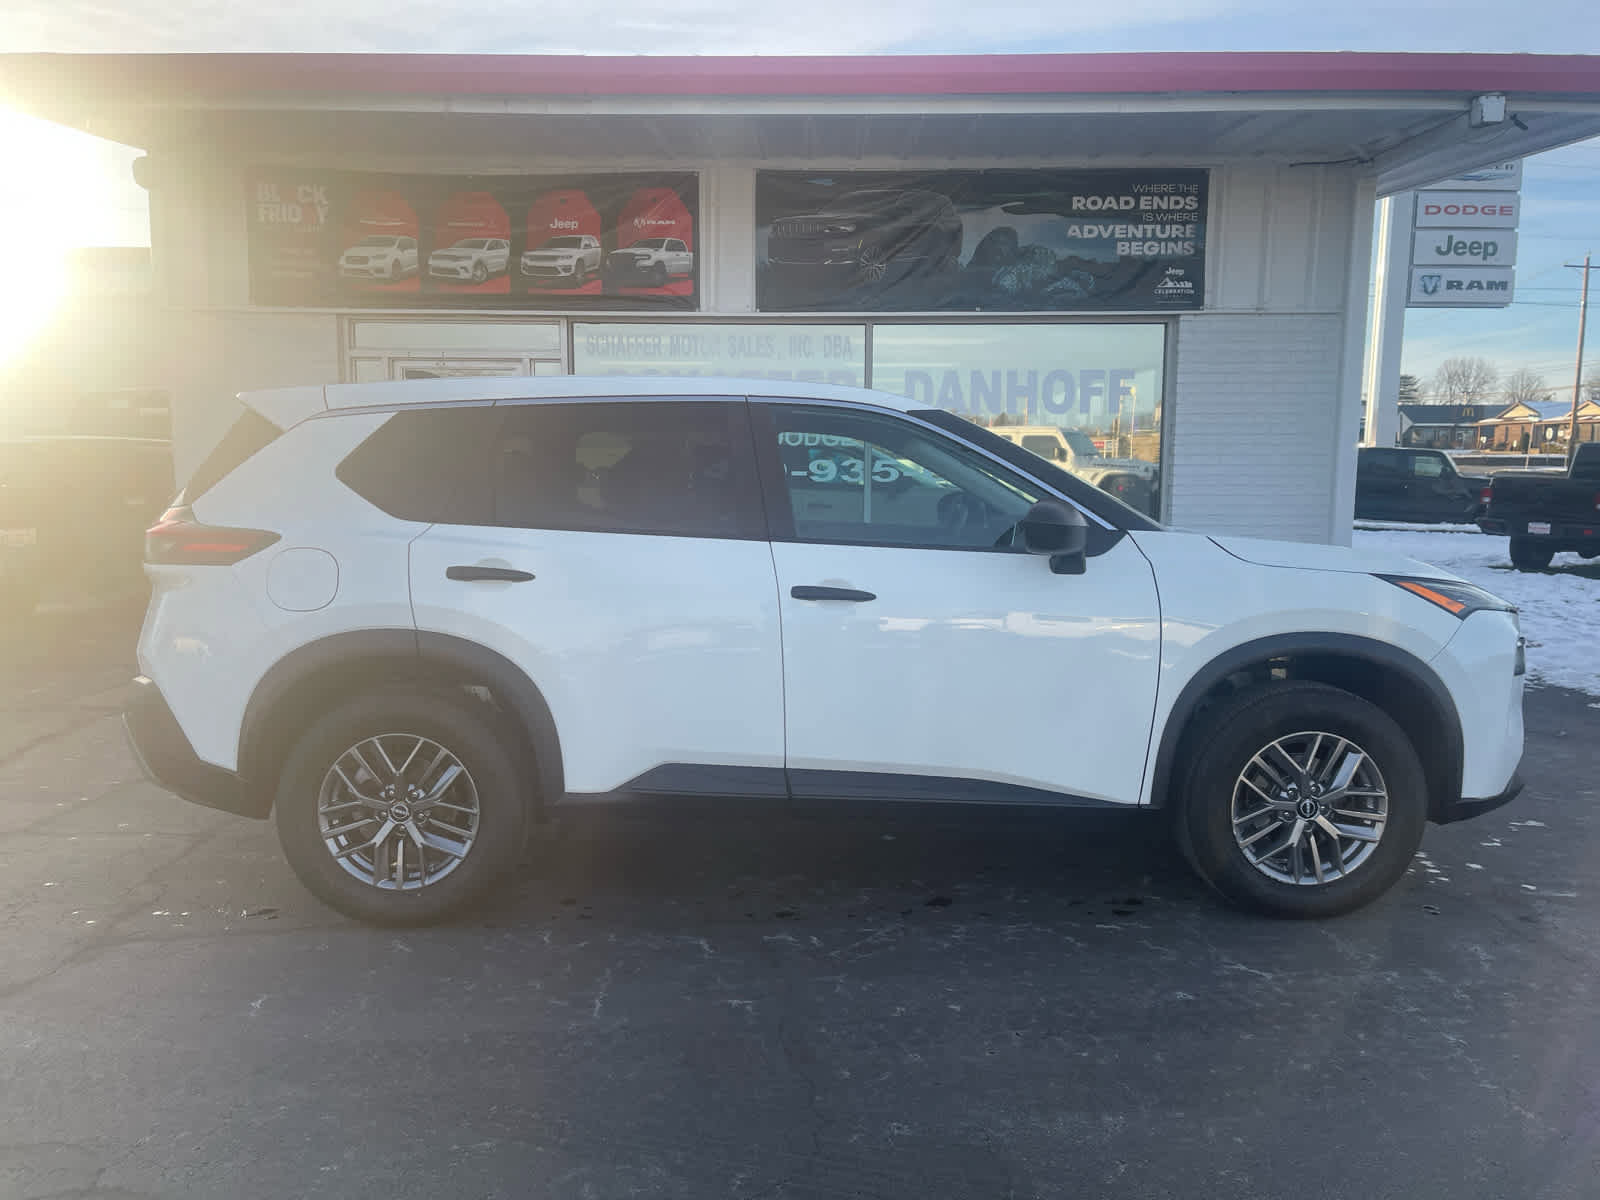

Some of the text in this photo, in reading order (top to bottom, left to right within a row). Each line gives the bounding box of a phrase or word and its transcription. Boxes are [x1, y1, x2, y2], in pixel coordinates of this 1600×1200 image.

[1132, 184, 1199, 192] WHERE THE
[1072, 196, 1199, 210] ROAD ENDS
[1424, 204, 1513, 216] DODGE
[550, 217, 579, 230] Jeep
[1143, 212, 1198, 222] IS WHERE
[1067, 224, 1197, 239] ADVENTURE
[1117, 241, 1196, 256] BEGINS
[1435, 234, 1499, 262] Jeep
[1165, 267, 1185, 276] Jeep
[1446, 280, 1509, 291] RAM
[670, 336, 721, 357] MOT
[823, 336, 853, 358] DBA
[904, 369, 1136, 414] DANHOFF
